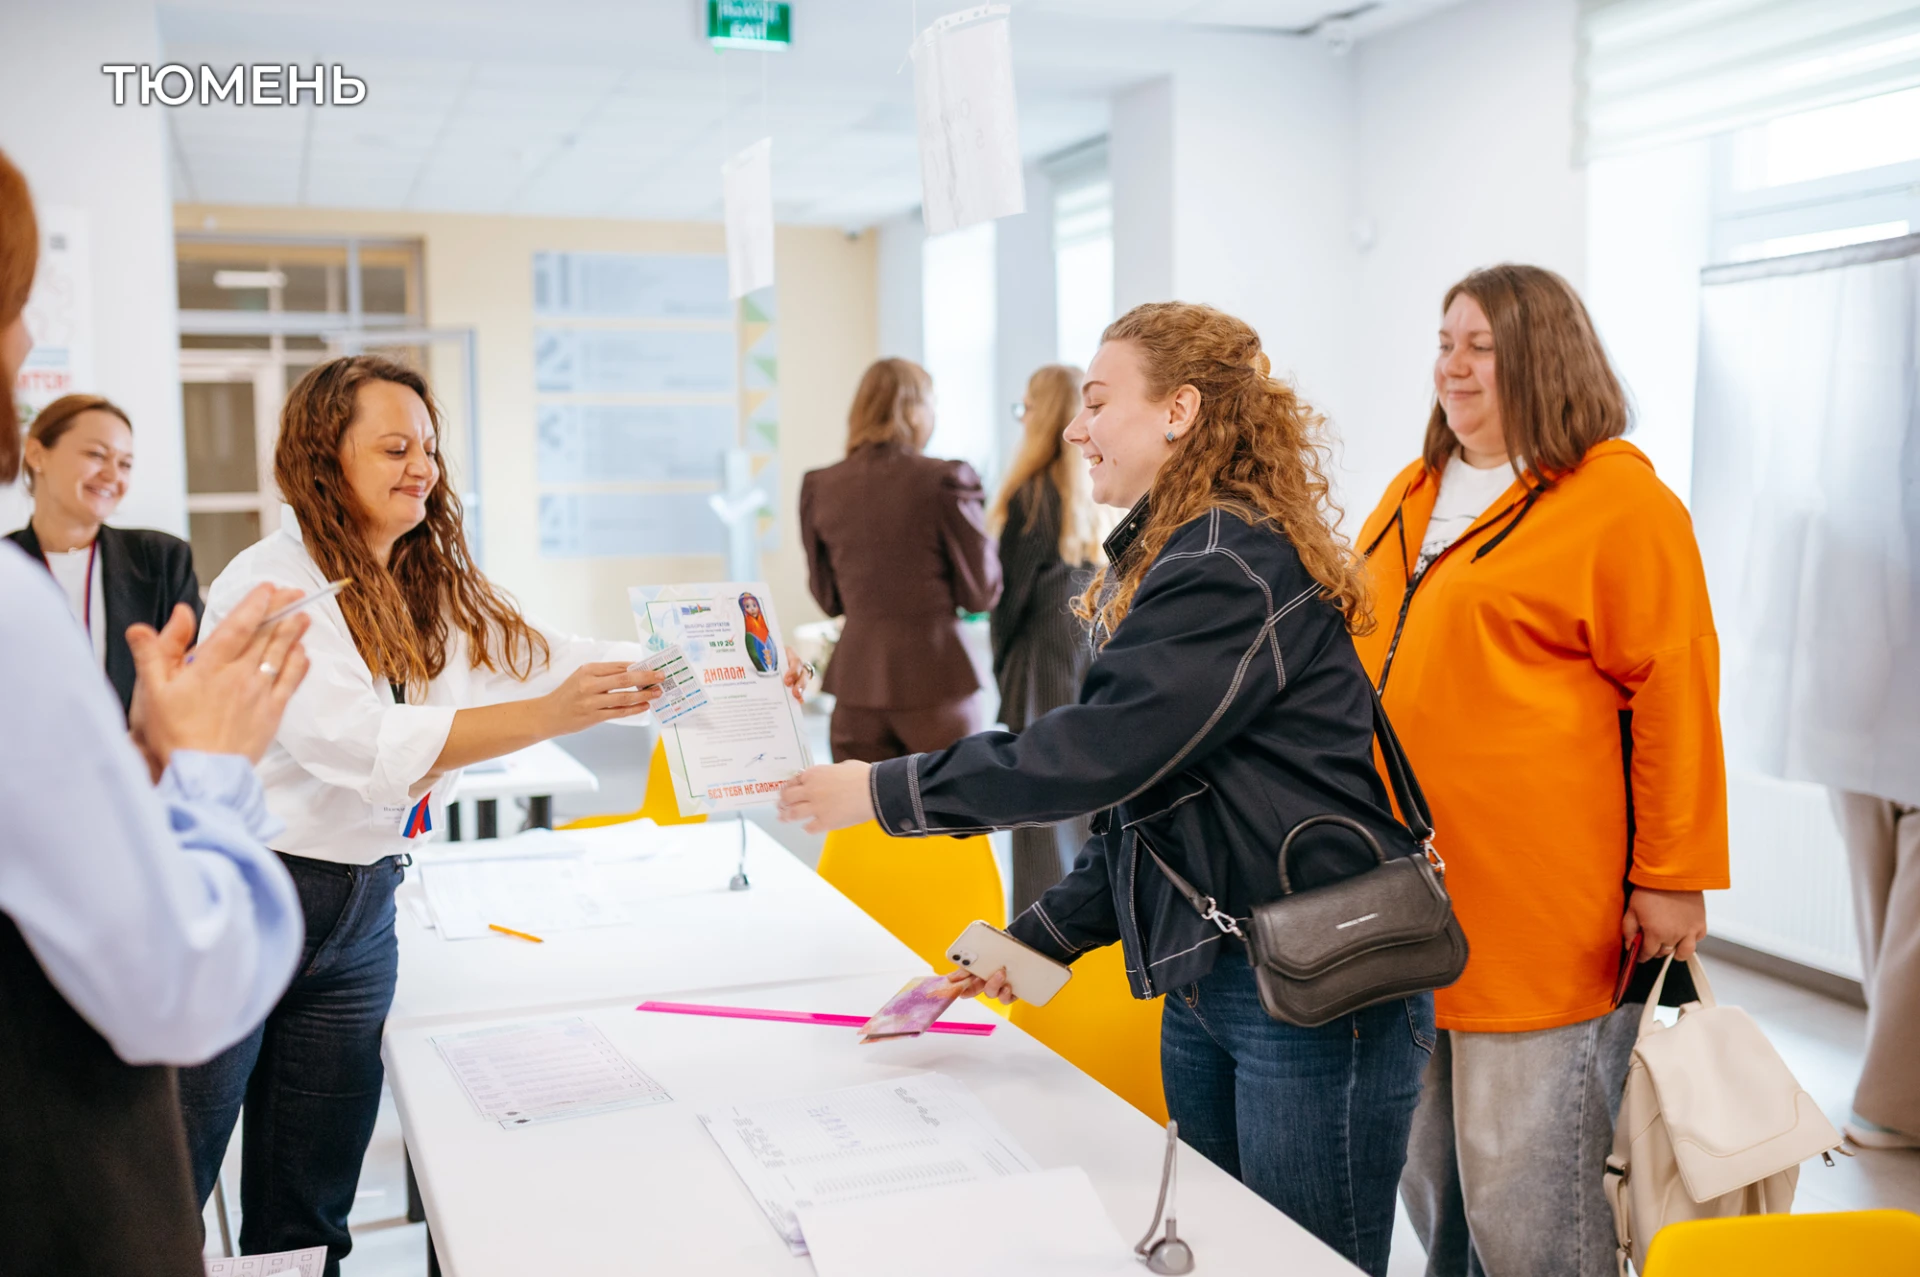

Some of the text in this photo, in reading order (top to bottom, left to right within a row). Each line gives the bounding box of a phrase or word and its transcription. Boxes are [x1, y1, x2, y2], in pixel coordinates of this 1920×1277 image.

[703, 666, 746, 684] ДИПЛОМ
[707, 788, 723, 800] БЕЗ
[723, 785, 744, 797] ТЕБЯ
[744, 783, 755, 795] НЕ
